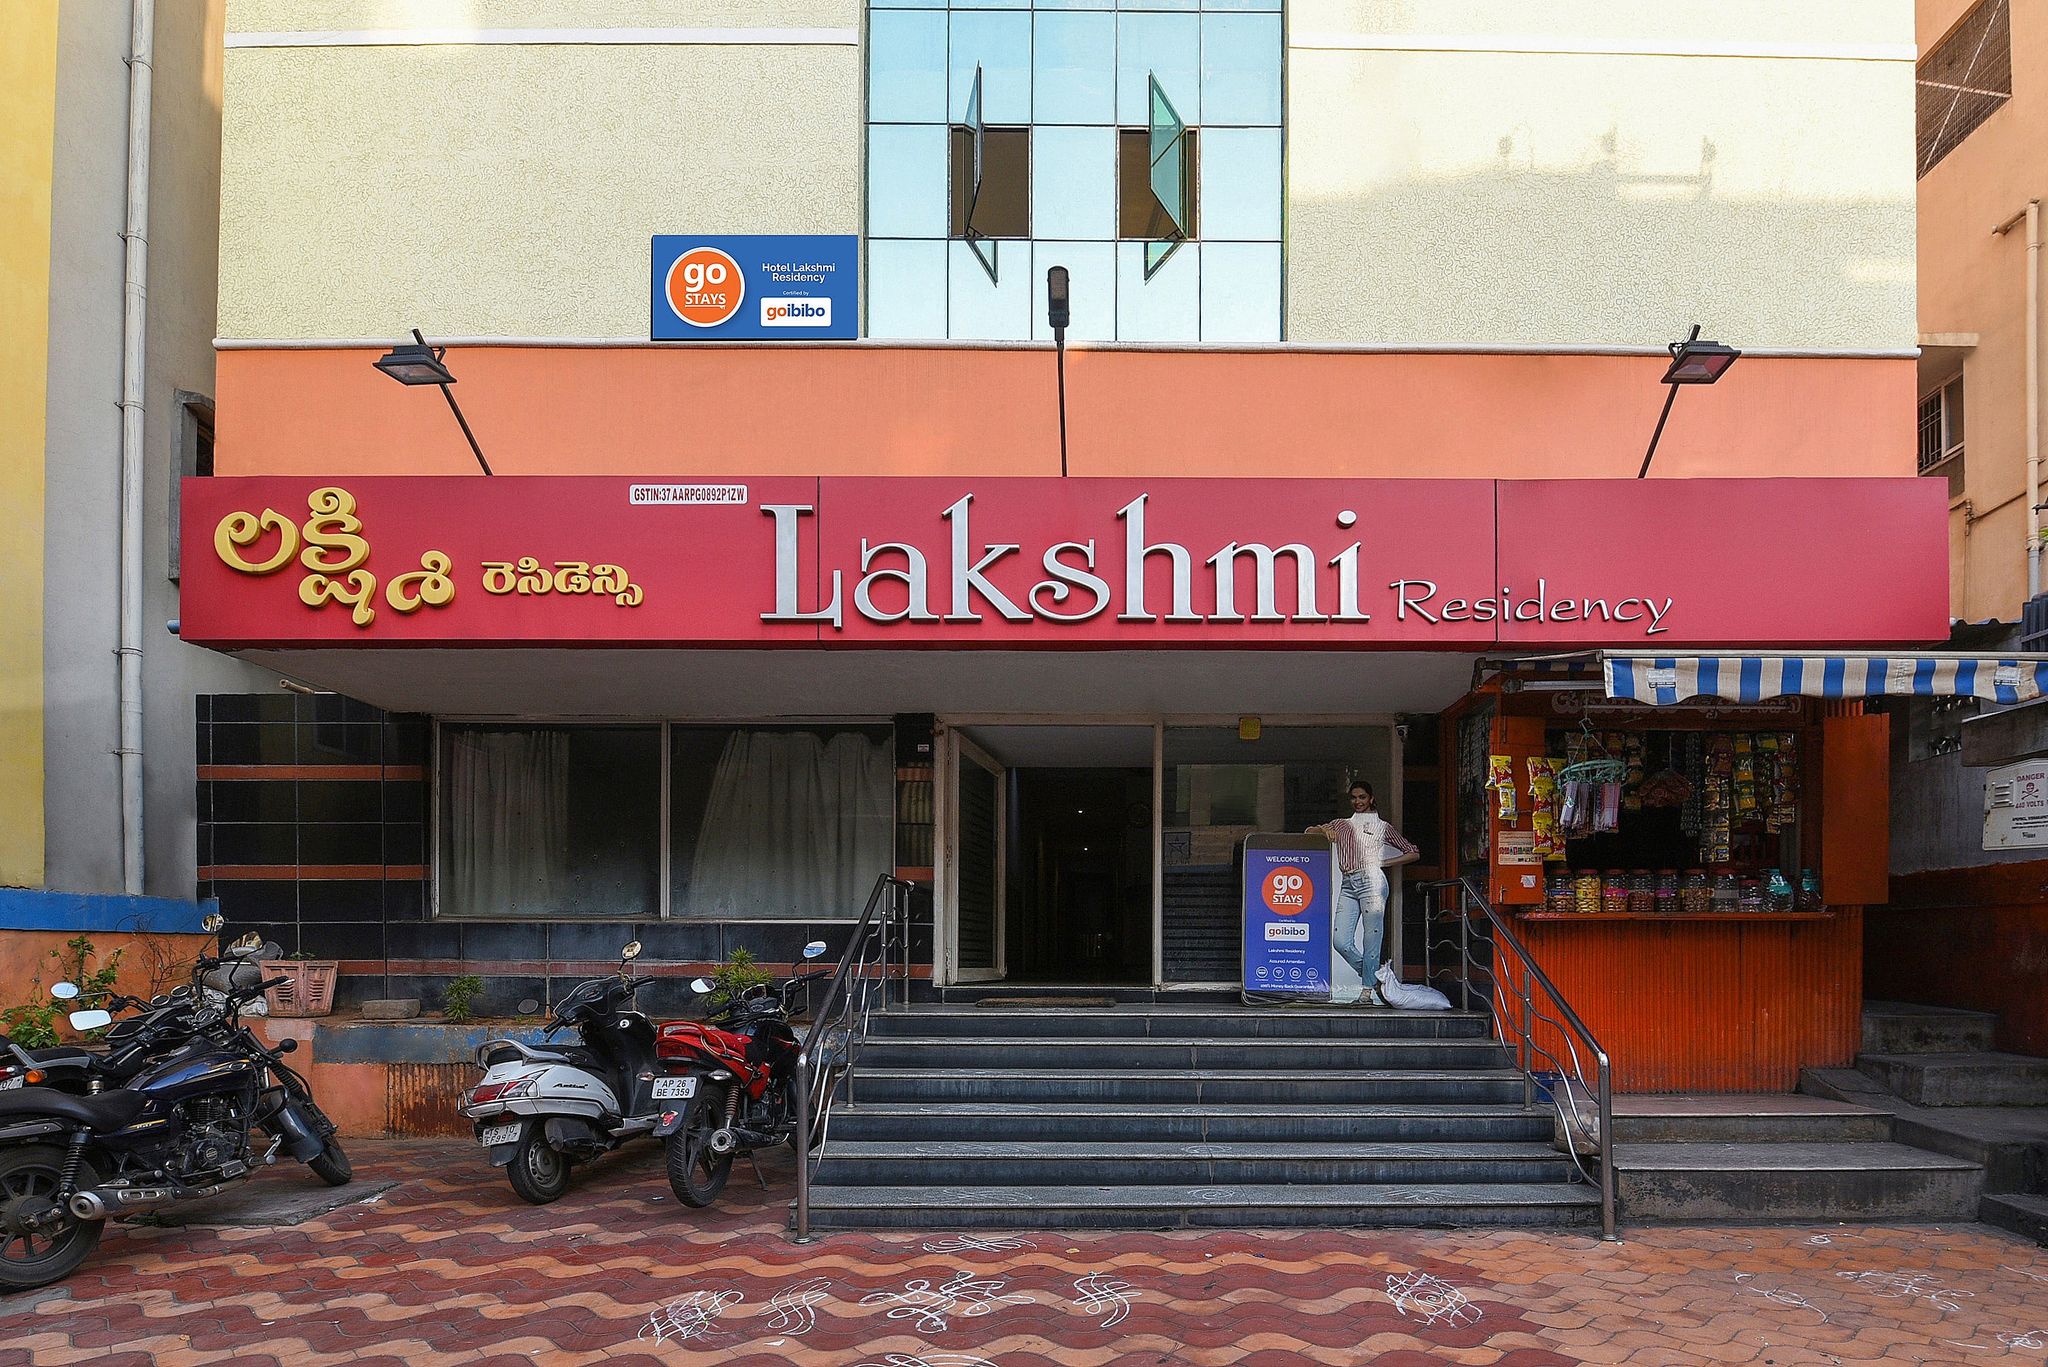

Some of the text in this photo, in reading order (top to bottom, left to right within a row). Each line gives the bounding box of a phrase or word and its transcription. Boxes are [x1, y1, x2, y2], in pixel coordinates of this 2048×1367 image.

[762, 263, 836, 272] Hotel Lakshmi
[683, 263, 727, 292] go
[772, 273, 825, 284] Residency
[685, 293, 727, 305] STAYS
[767, 303, 826, 321] goibibo
[760, 493, 1674, 635] Lakshmi Residency
[2016, 772, 2045, 783] DANGER
[2026, 800, 2044, 808] VOLTS
[1265, 855, 1300, 863] WELCOME
[1273, 874, 1303, 895] go
[1272, 894, 1303, 903] STAYS
[1268, 926, 1306, 938] goibibo
[661, 1079, 687, 1088] AP 26
[656, 1088, 690, 1097] BE 7359
